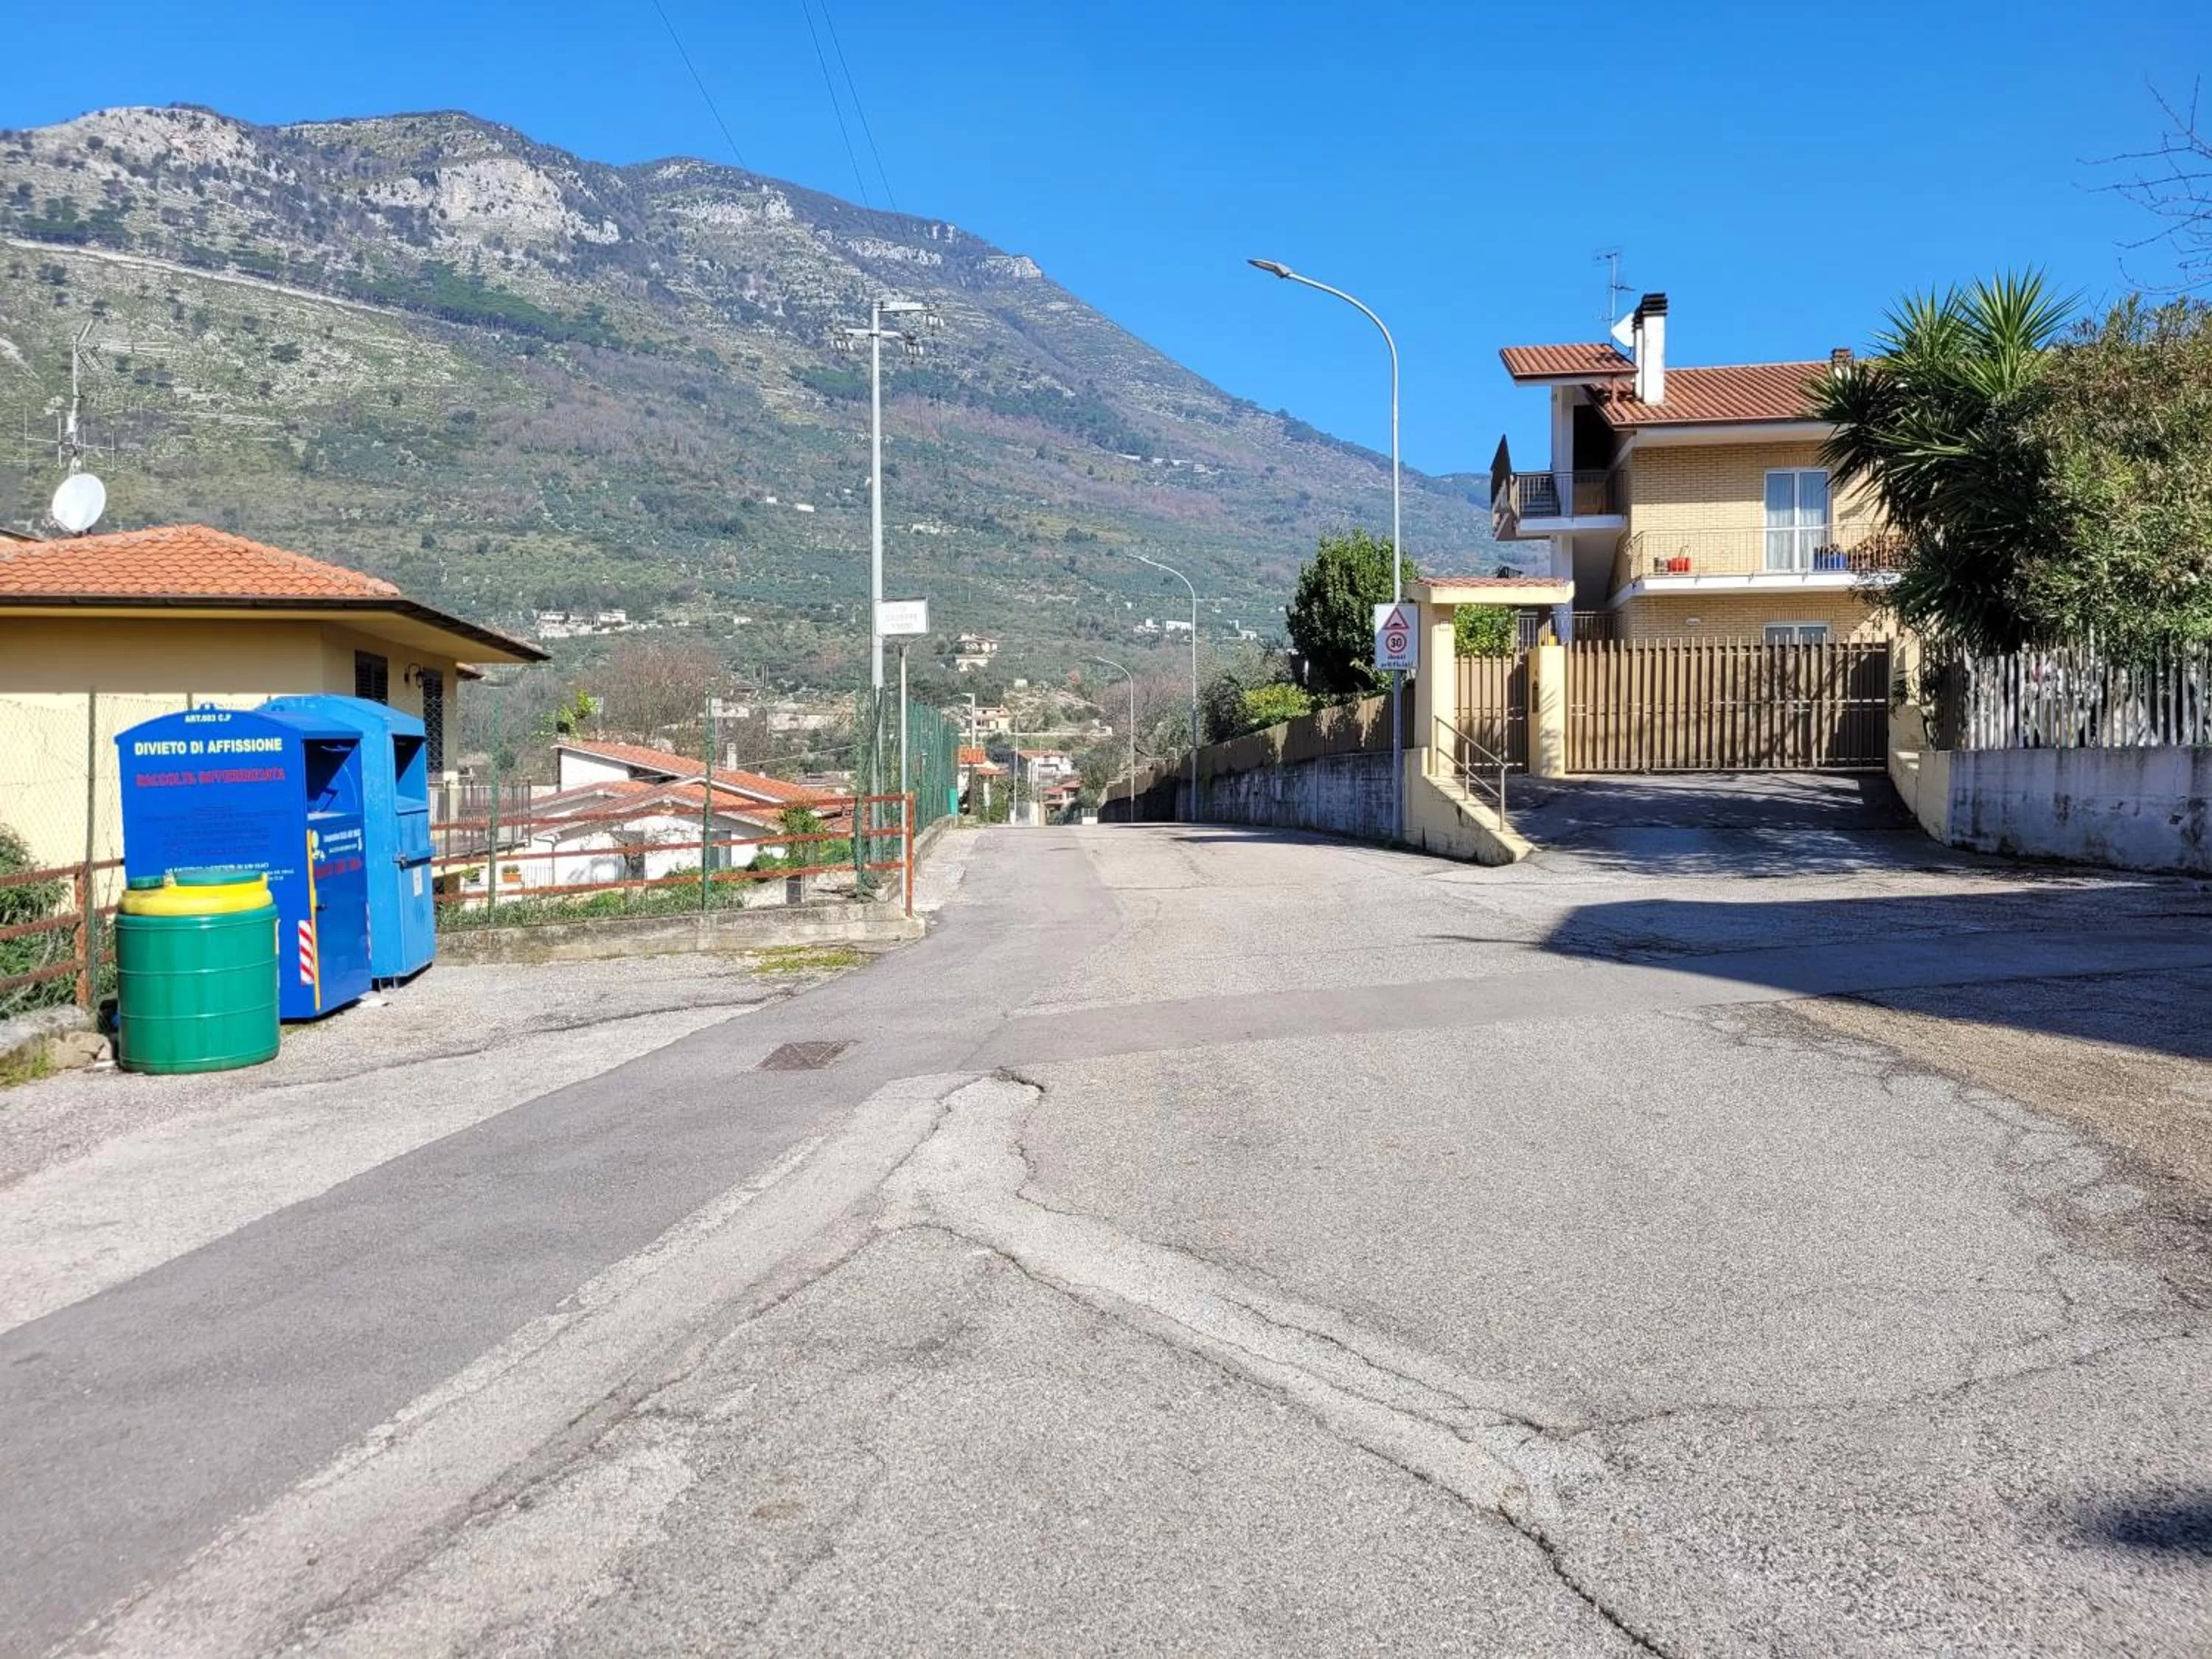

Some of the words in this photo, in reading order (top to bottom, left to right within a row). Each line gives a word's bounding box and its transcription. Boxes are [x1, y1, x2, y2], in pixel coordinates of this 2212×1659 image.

[1391, 638, 1402, 648] 30
[135, 740, 187, 756] DIVIETO
[190, 740, 204, 754] DI
[207, 737, 283, 754] AFFISSIONE
